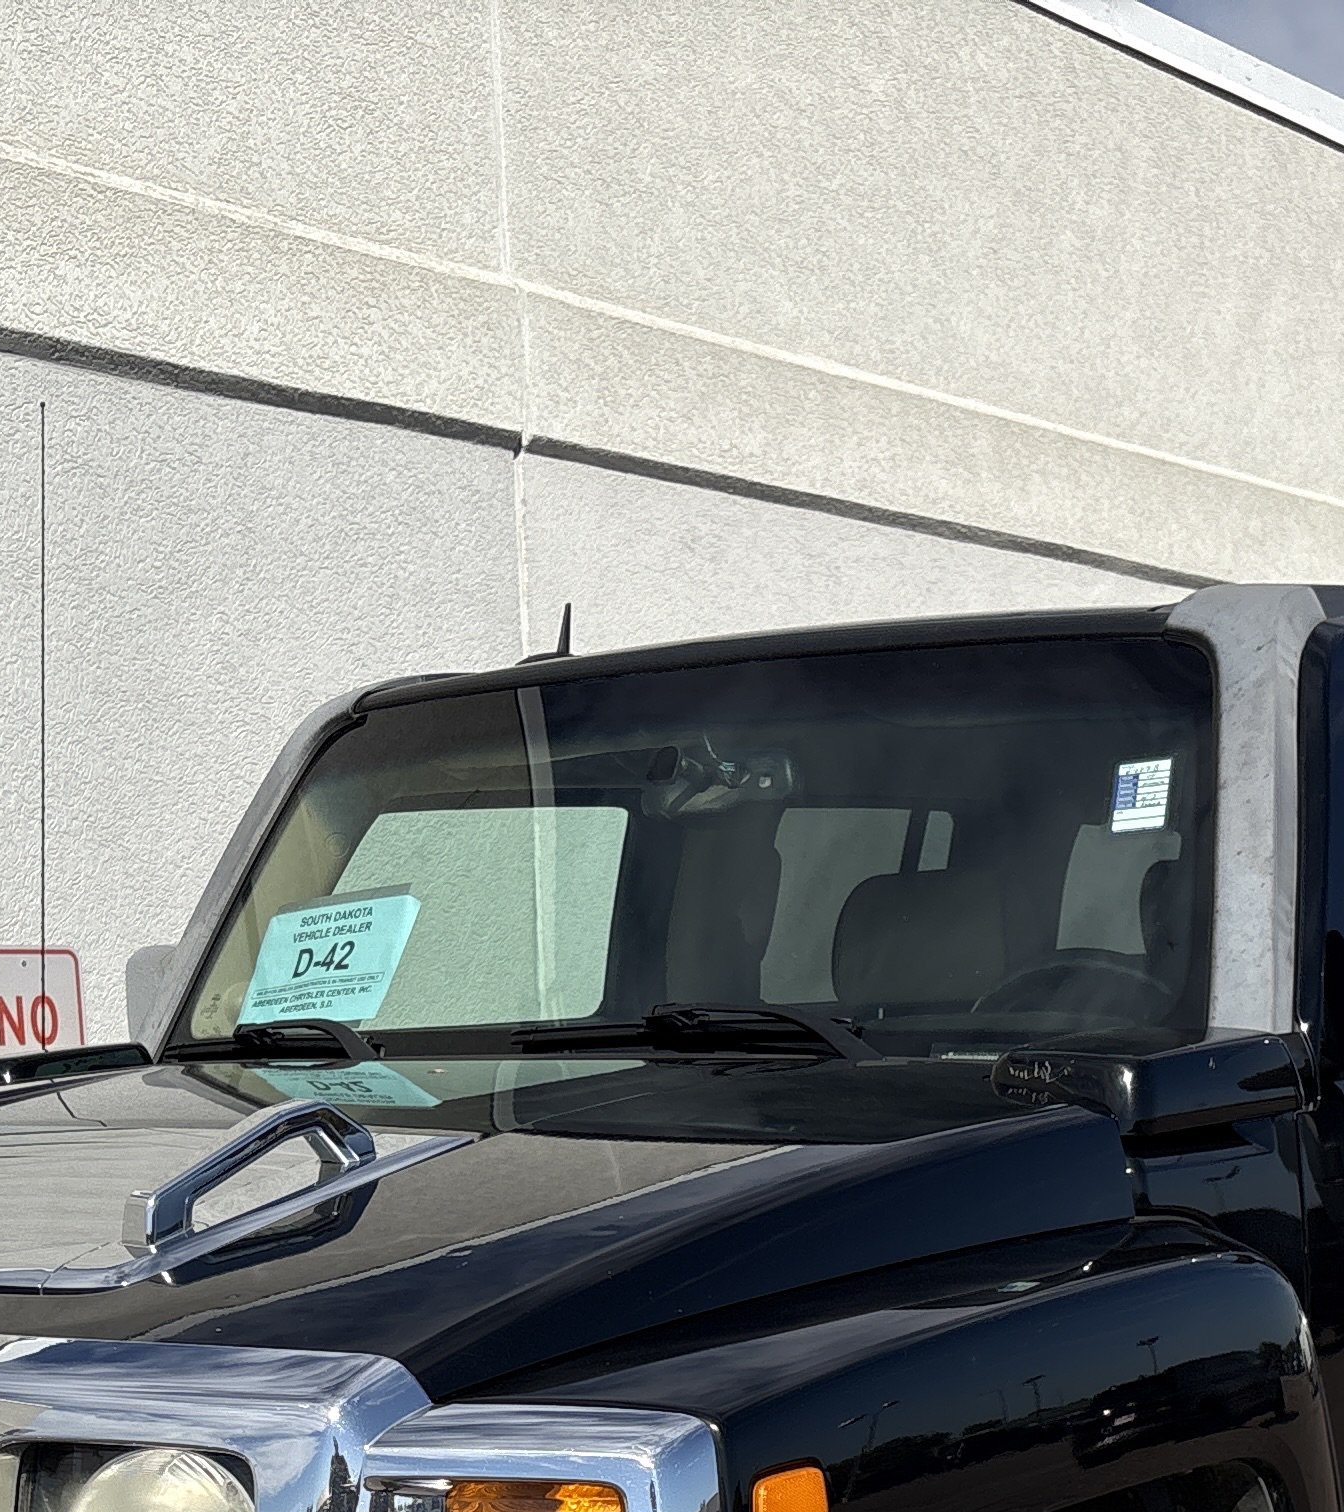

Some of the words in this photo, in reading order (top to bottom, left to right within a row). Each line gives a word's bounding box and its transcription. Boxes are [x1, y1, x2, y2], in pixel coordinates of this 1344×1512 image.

[299, 913, 332, 928] SOUTH
[333, 906, 373, 921] DAKOTA
[293, 928, 331, 943] VEHICLE
[332, 921, 373, 937] DEALER
[292, 940, 356, 979] D-42
[289, 990, 325, 1003] CHRYSLER
